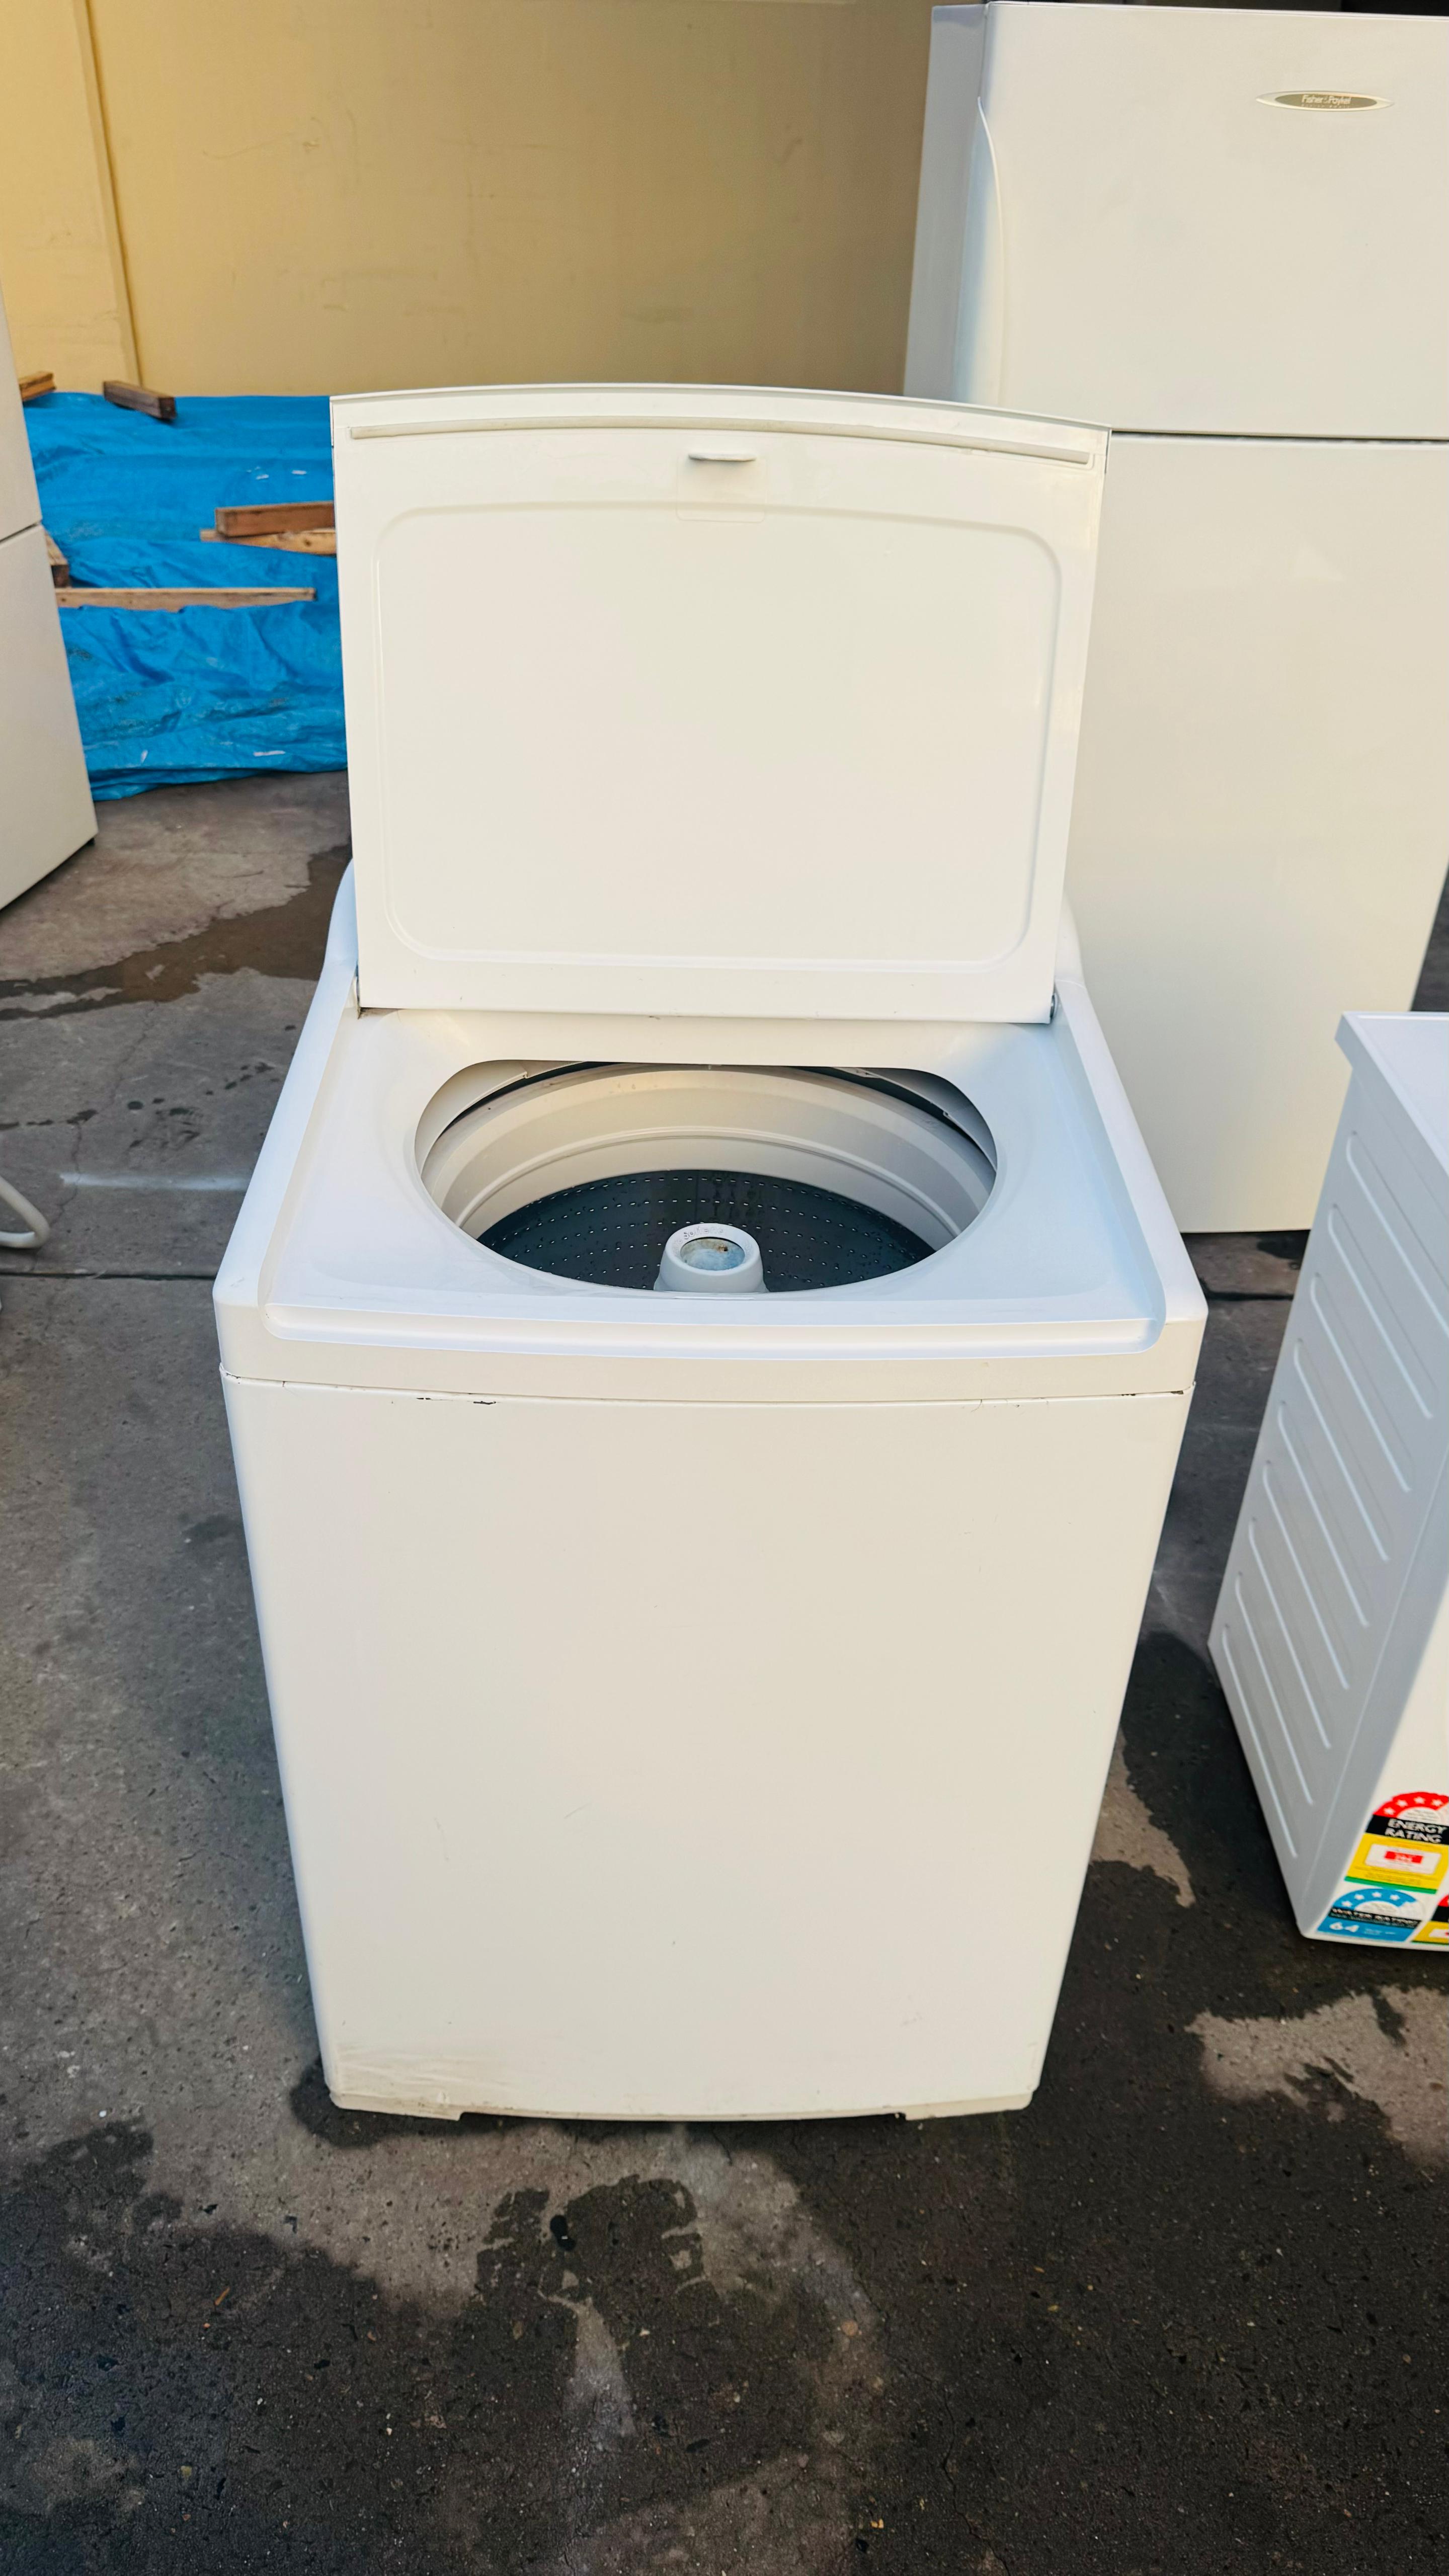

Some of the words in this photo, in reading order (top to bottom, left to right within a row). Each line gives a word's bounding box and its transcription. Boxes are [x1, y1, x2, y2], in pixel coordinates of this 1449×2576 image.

[1301, 94, 1323, 103] Fisher
[1328, 96, 1352, 105] Paykel
[1387, 1818, 1447, 1834] ENERGY
[1385, 1827, 1443, 1843] RATING
